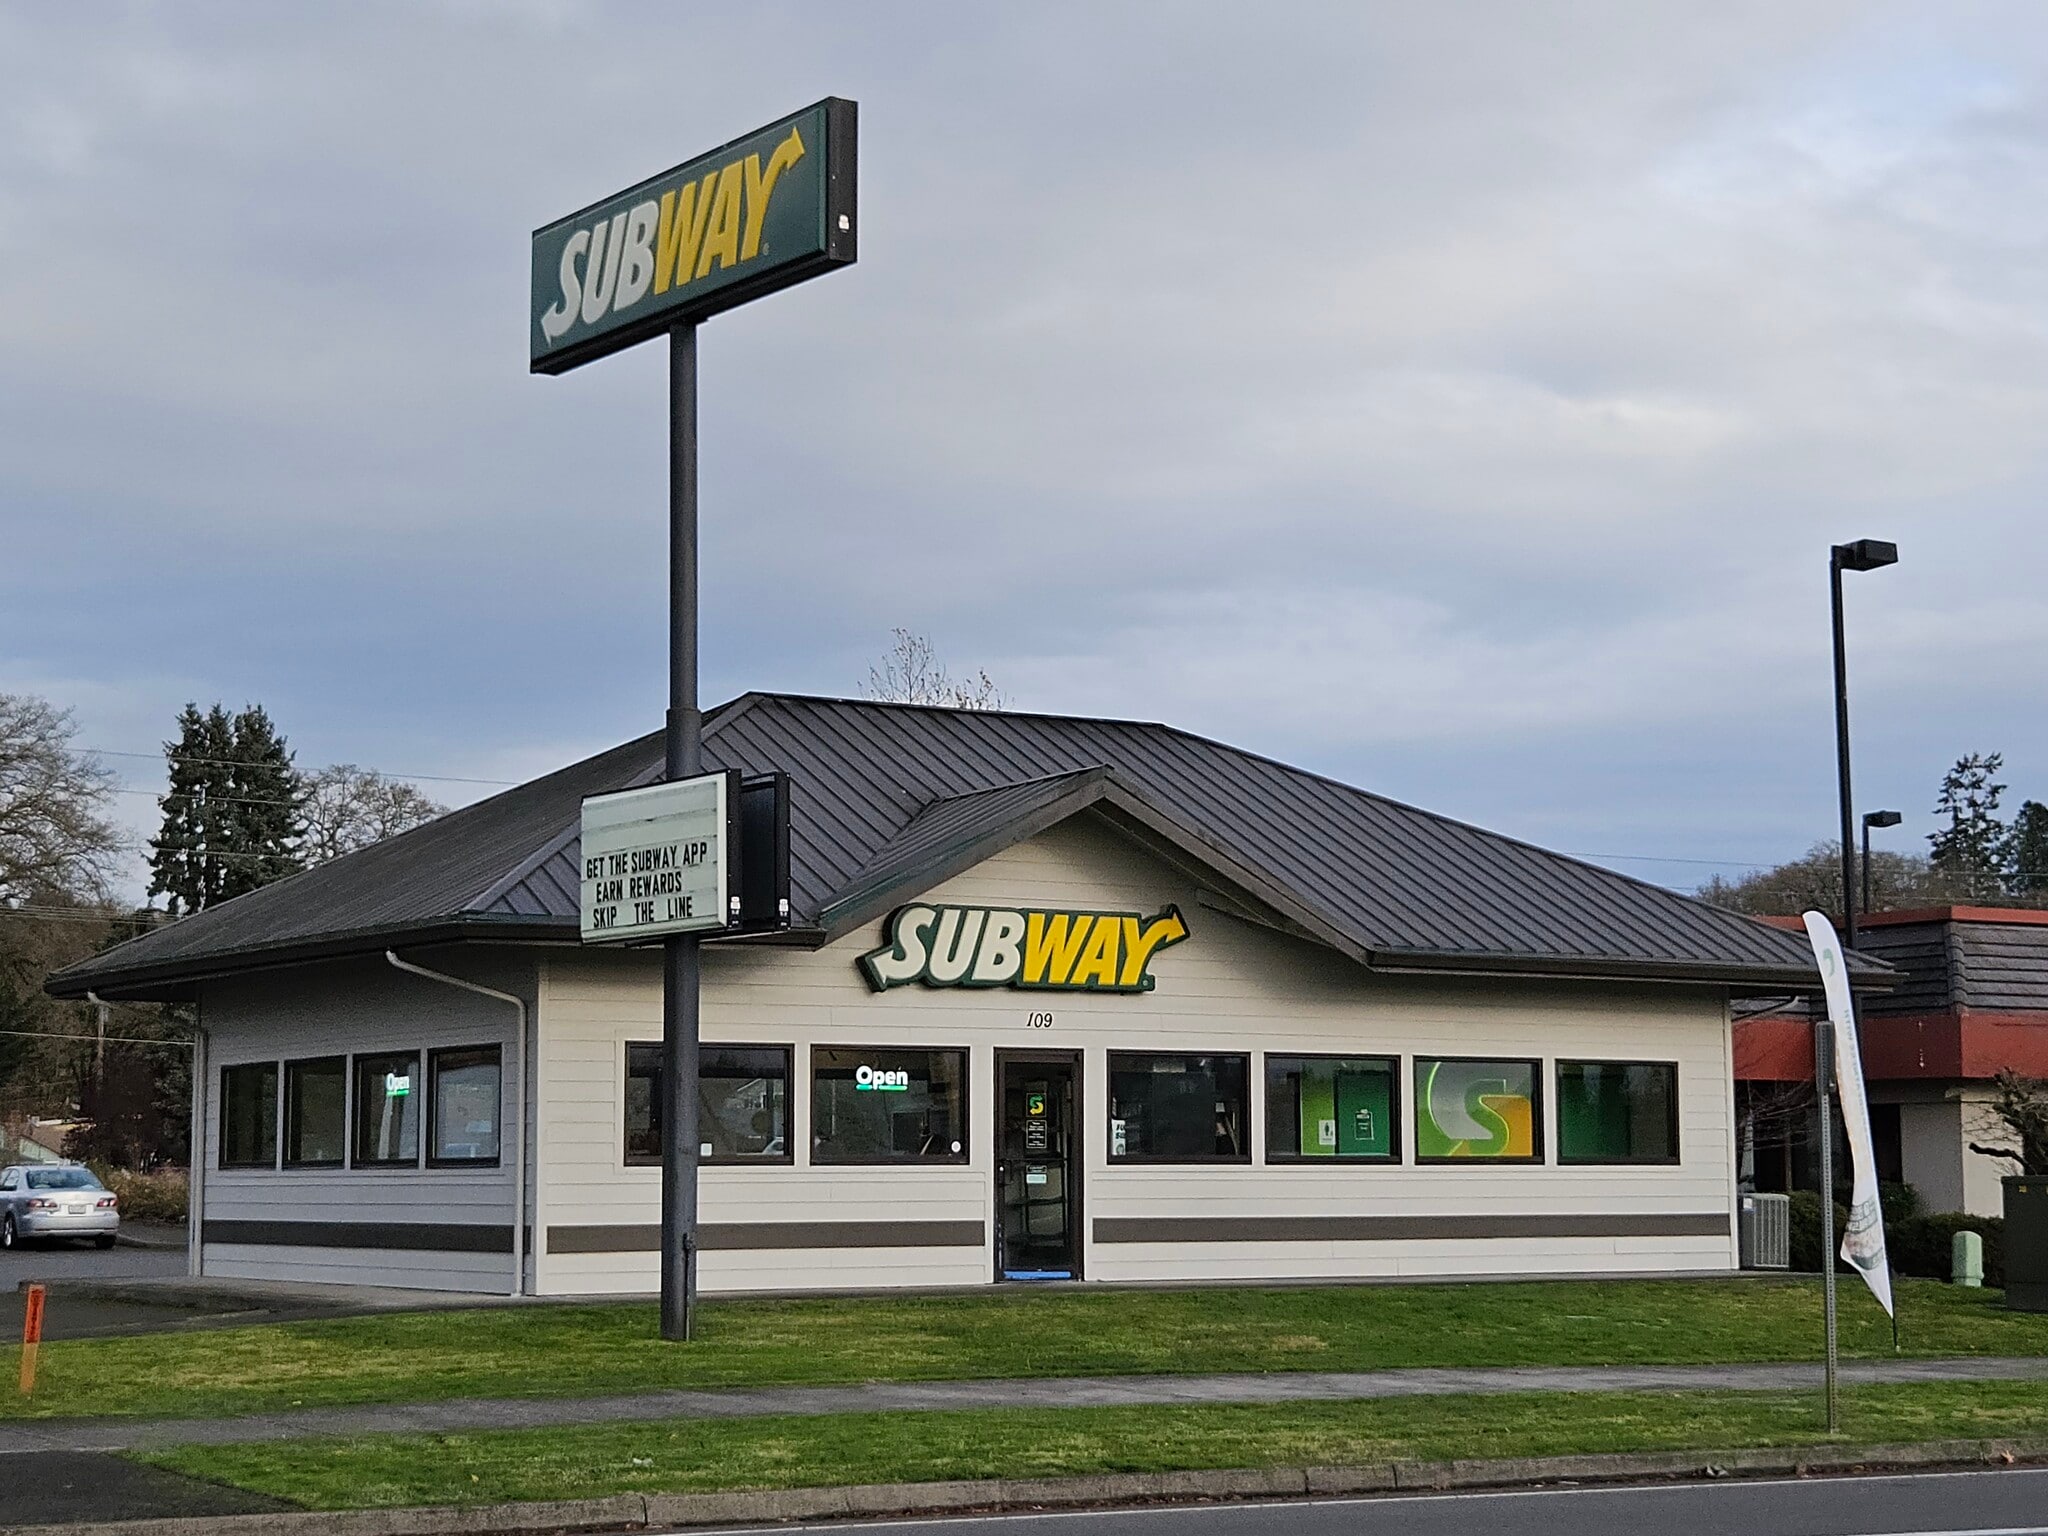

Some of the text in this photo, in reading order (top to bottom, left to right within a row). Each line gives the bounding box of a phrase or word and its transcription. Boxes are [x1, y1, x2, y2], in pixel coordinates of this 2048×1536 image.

[541, 126, 805, 346] SUBWAY
[586, 841, 707, 879] GET THE SUBWAY APP
[596, 871, 682, 903] EARN REWARDS
[593, 896, 692, 928] SKIP THE LINE
[872, 906, 1187, 986] SUBWAY
[1026, 1011, 1053, 1028] 109
[856, 1064, 909, 1088] Open
